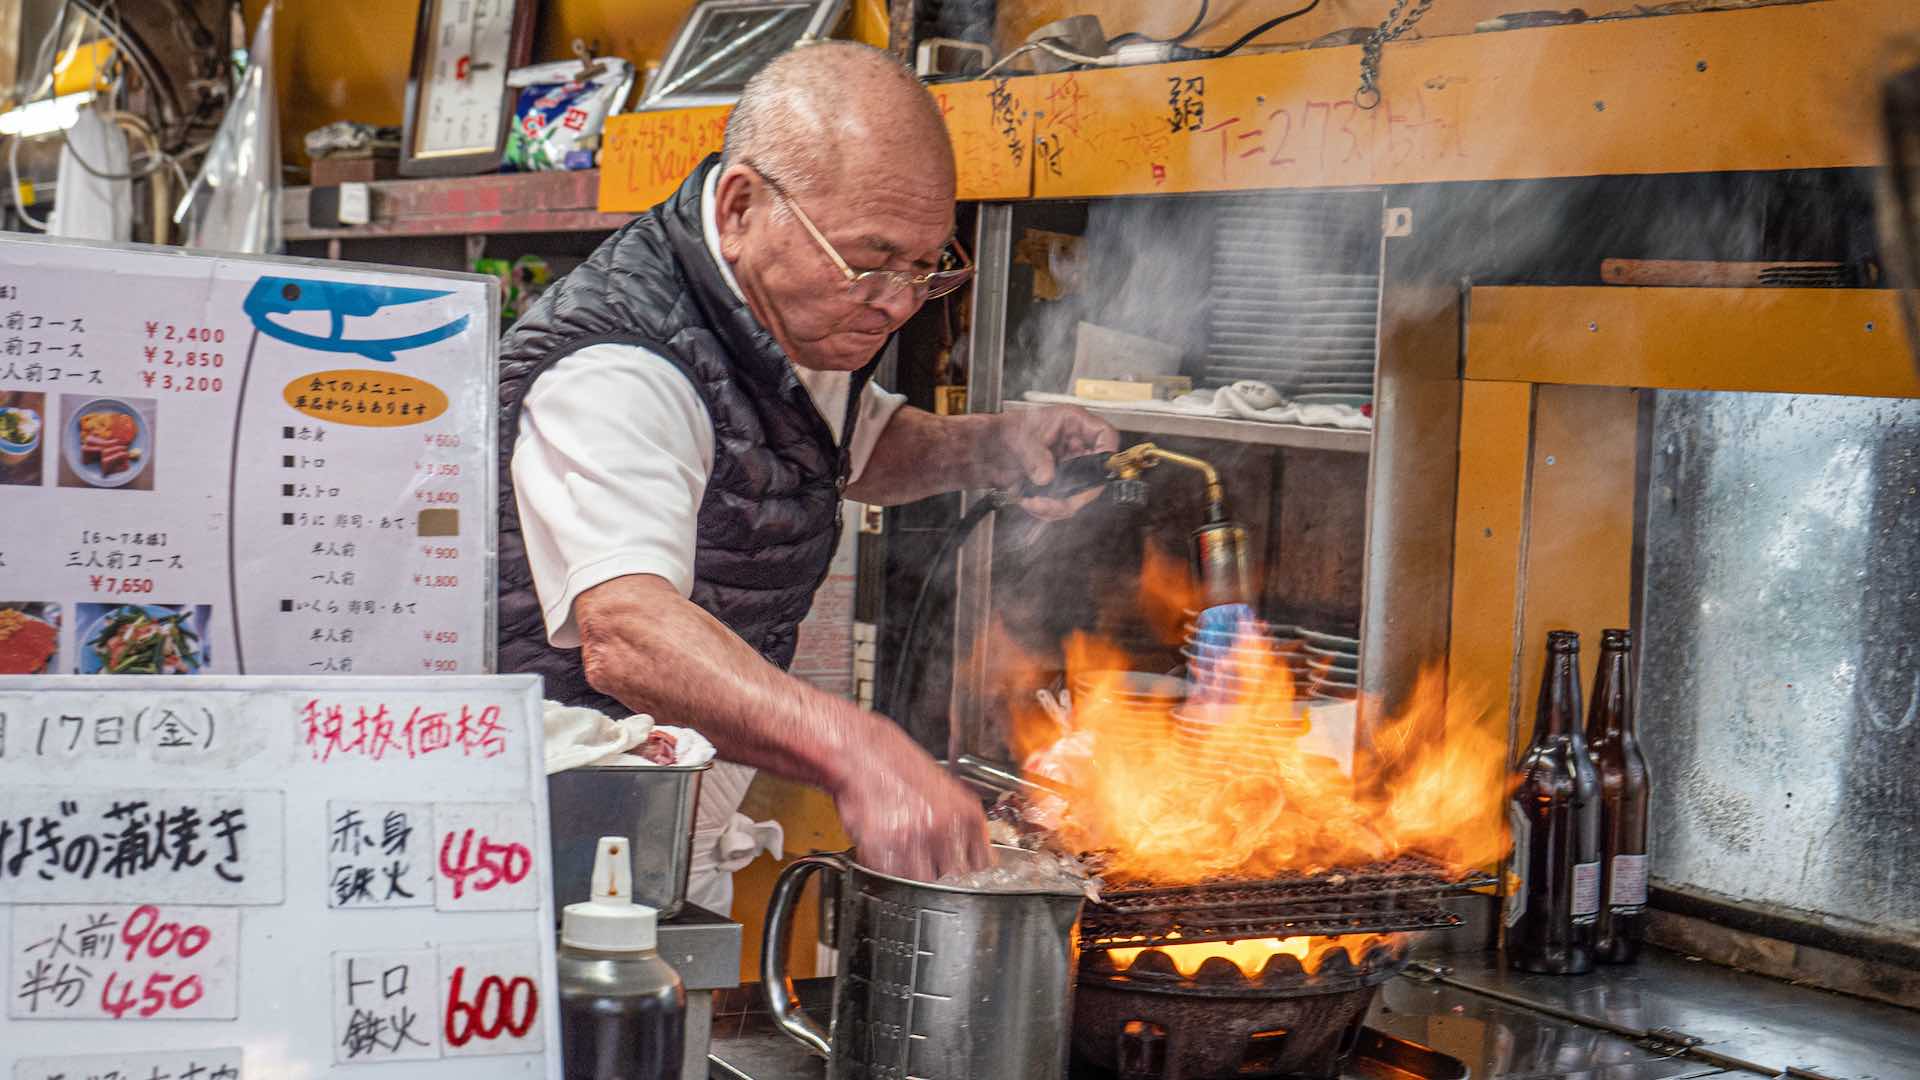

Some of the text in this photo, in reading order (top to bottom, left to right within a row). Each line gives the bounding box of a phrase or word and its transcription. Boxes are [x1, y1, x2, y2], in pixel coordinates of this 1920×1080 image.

[145, 321, 225, 343] ¥2,400
[144, 346, 224, 368] ¥2,850
[143, 371, 223, 392] ¥3,200
[310, 377, 413, 395] 全てのメニュー
[301, 455, 326, 468] トロ
[298, 484, 340, 498] 大トロ
[300, 513, 325, 528] うに
[312, 542, 356, 557] 半人前
[424, 546, 458, 559] ¥900
[65, 550, 184, 569] 三人前コース
[90, 575, 153, 594] ¥7,650
[311, 571, 355, 586] 一人前
[297, 600, 339, 614] いくら
[310, 628, 353, 644] 半人前
[424, 630, 458, 644] ¥450
[309, 656, 353, 672] 一人前
[299, 699, 507, 763] 税抜価格
[330, 809, 413, 856] 赤身
[438, 828, 532, 900] 450
[330, 861, 415, 906] 鉄火
[23, 903, 212, 962] 一人前 900
[17, 959, 205, 1020] 半分 450
[346, 958, 409, 1006] トロ
[444, 965, 539, 1048] 600
[341, 1005, 431, 1059] 鉄火
